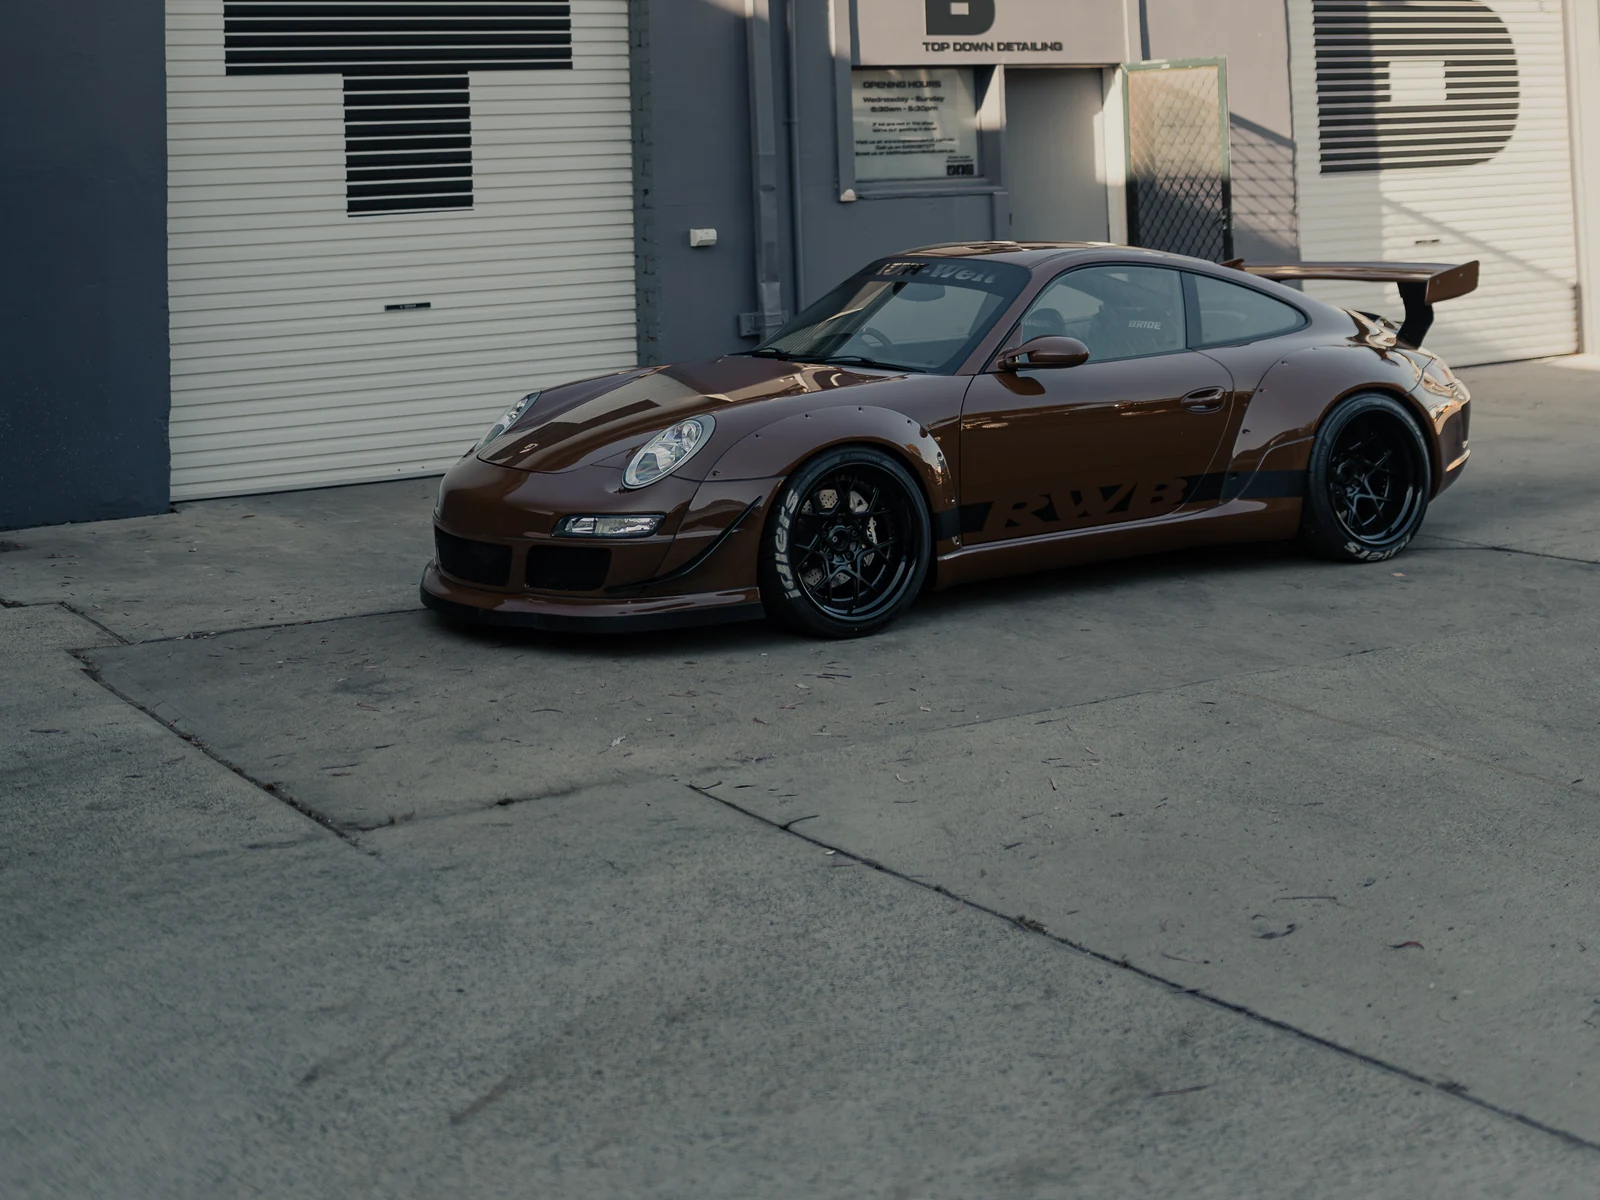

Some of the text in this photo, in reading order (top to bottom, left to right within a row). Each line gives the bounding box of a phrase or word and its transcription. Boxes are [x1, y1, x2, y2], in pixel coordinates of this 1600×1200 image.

[922, 41, 1063, 52] TOP DOWN DETAILING
[863, 80, 942, 89] OPENING HOURS
[863, 96, 909, 104] Wednesday
[915, 95, 945, 103] Sunday
[1128, 320, 1162, 330] BRIDE
[982, 476, 1189, 533] RWB
